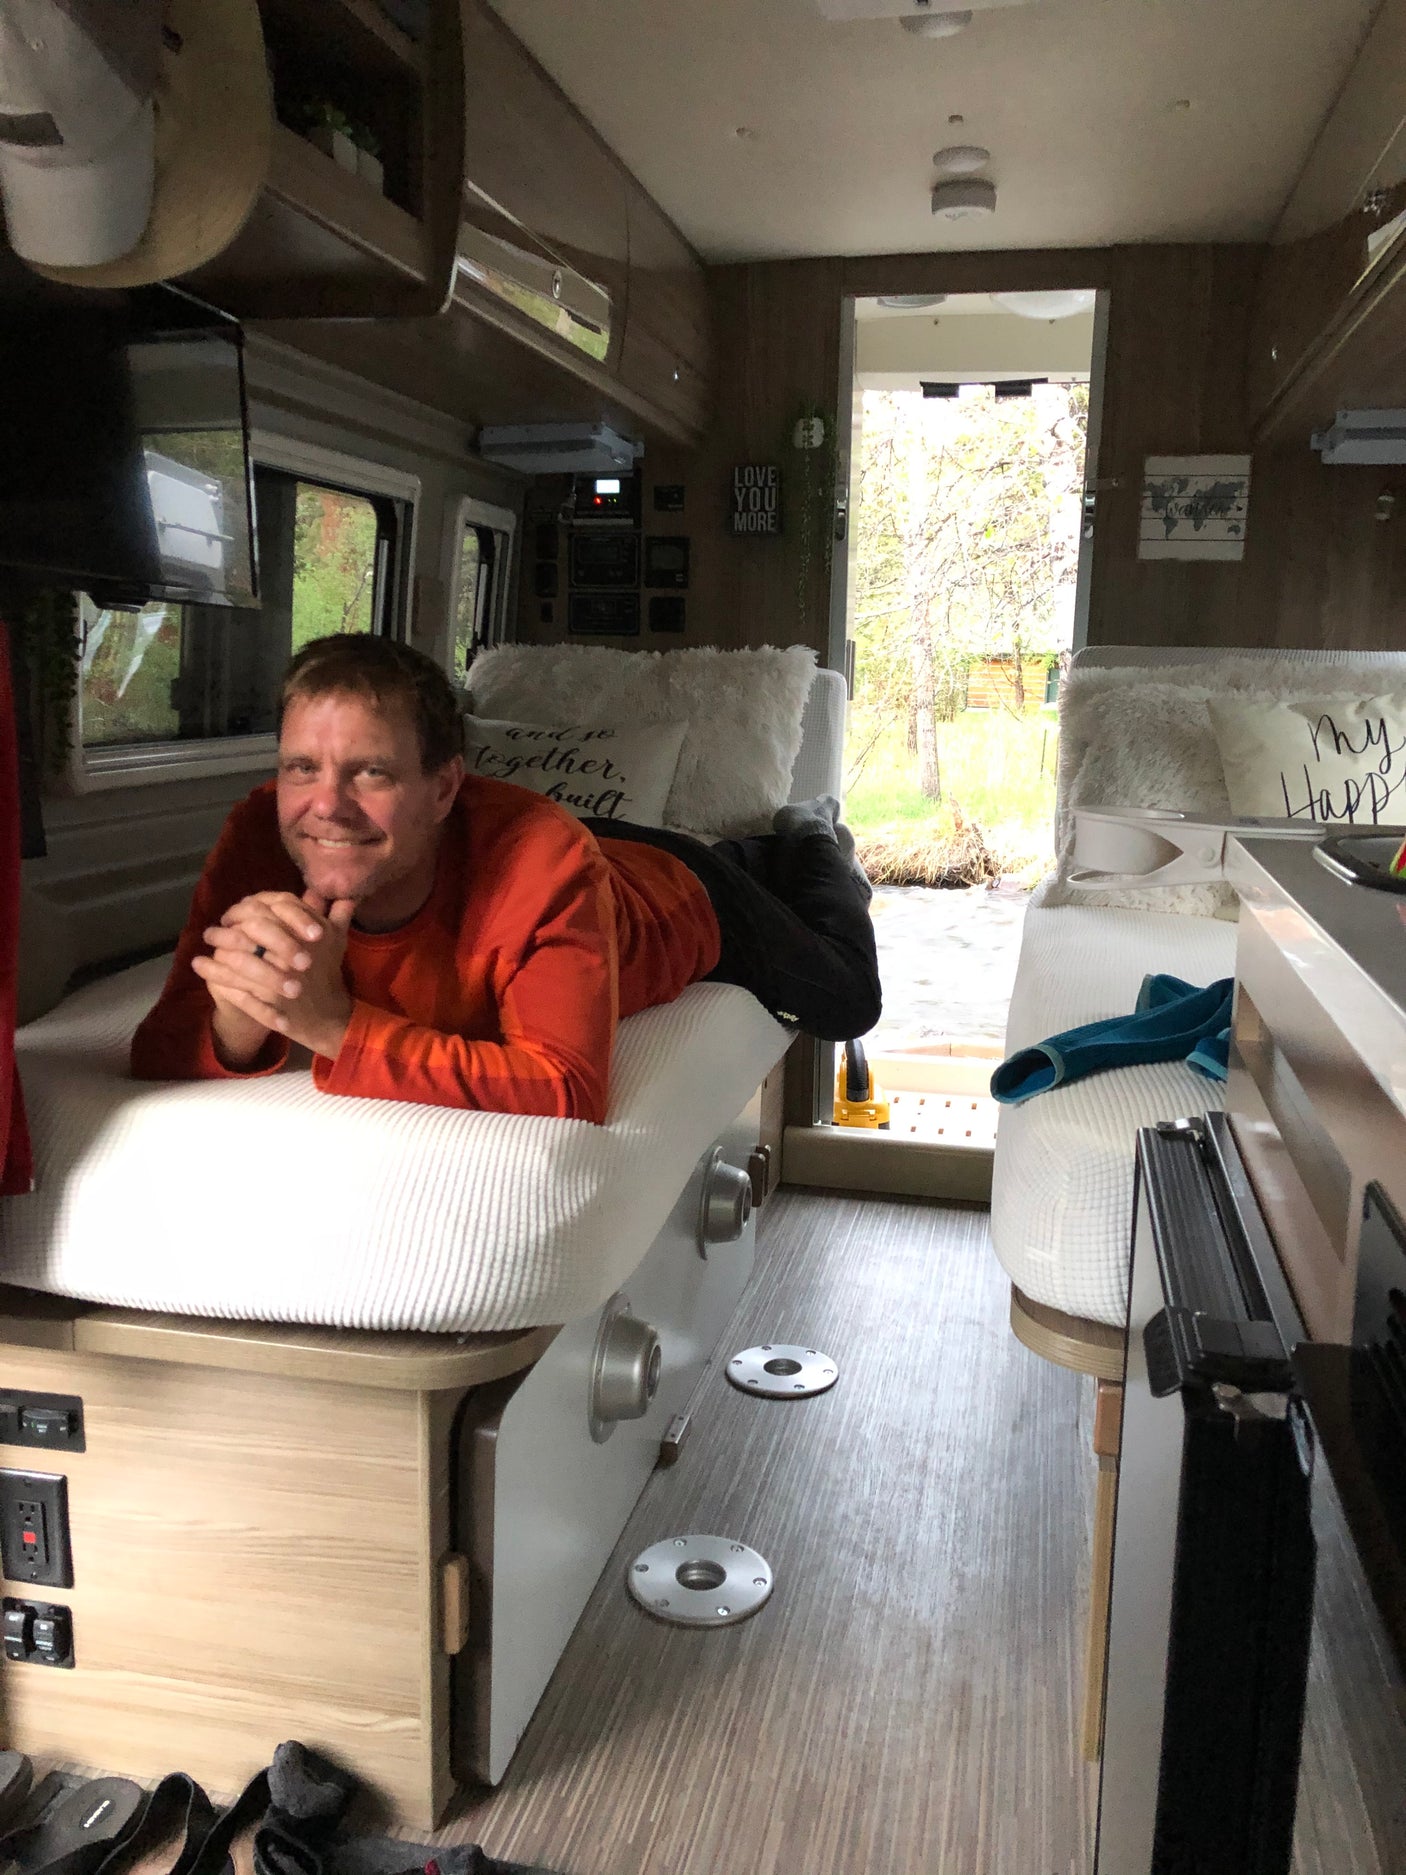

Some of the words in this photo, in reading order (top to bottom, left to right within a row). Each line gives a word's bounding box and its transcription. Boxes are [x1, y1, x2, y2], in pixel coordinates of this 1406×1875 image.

[734, 466, 777, 487] LOVE
[734, 487, 777, 512] YOU
[734, 511, 777, 532] MORE
[1281, 763, 1406, 825] Happ
